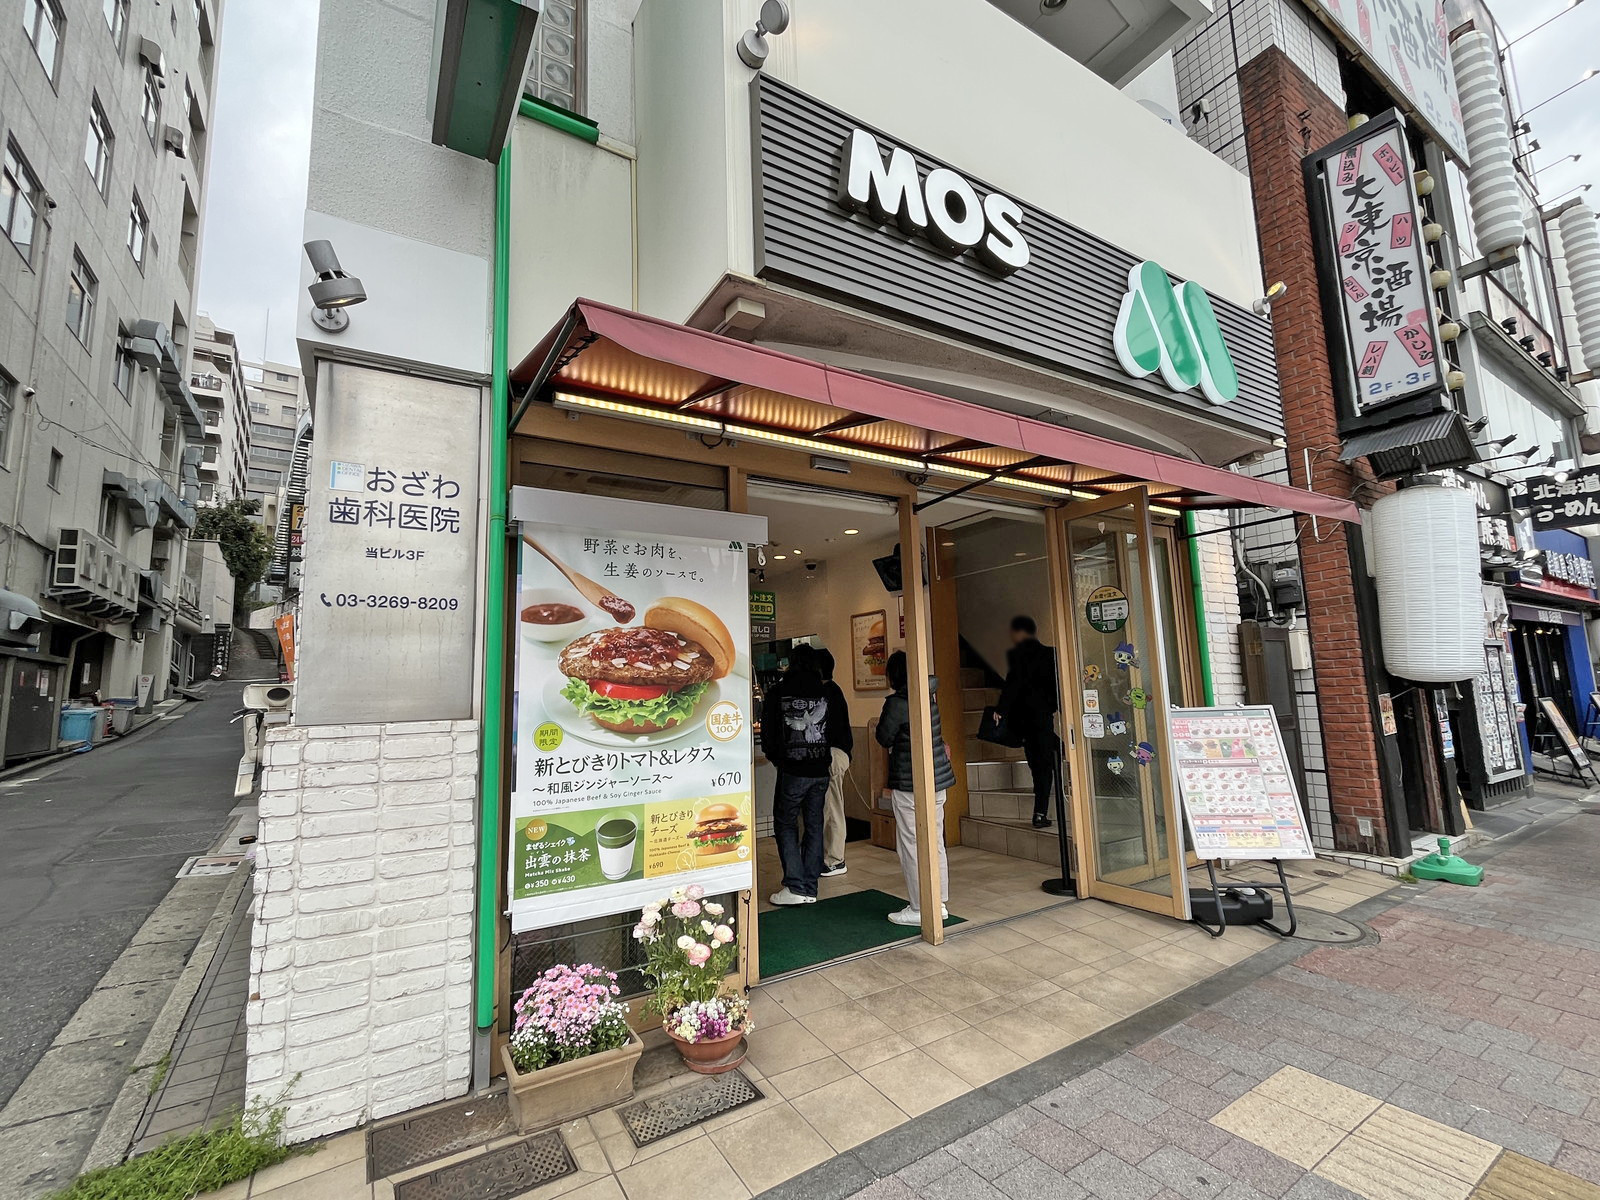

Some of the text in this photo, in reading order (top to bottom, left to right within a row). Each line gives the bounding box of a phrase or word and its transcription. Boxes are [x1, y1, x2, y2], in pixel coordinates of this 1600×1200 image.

[846, 127, 1031, 269] MOS
[1342, 174, 1413, 333] 大東京酒場
[1403, 328, 1434, 361] かしら
[366, 466, 460, 500] おざわ
[1532, 472, 1600, 500] 北海道
[328, 496, 460, 534] 歯科医院
[1536, 497, 1600, 523] らーめん
[365, 547, 425, 561] 当ビル3F
[583, 538, 682, 560] 野菜とお肉を、
[603, 561, 704, 583] 生姜のソースで。
[335, 593, 459, 611] 03-3269-8209
[711, 711, 743, 726] 国産牛
[534, 746, 716, 778] 新とびきりトマト&レタス
[711, 771, 742, 788] ¥670
[532, 799, 554, 808] 100%
[555, 796, 585, 805] Japanese
[586, 794, 602, 802] Beef
[622, 790, 644, 799] Ginger
[644, 788, 662, 796] Sauce
[650, 809, 694, 825] 新とびきり
[527, 825, 546, 834] NEW
[650, 823, 679, 837] チーズ
[524, 848, 592, 870] 出雲の抹茶
